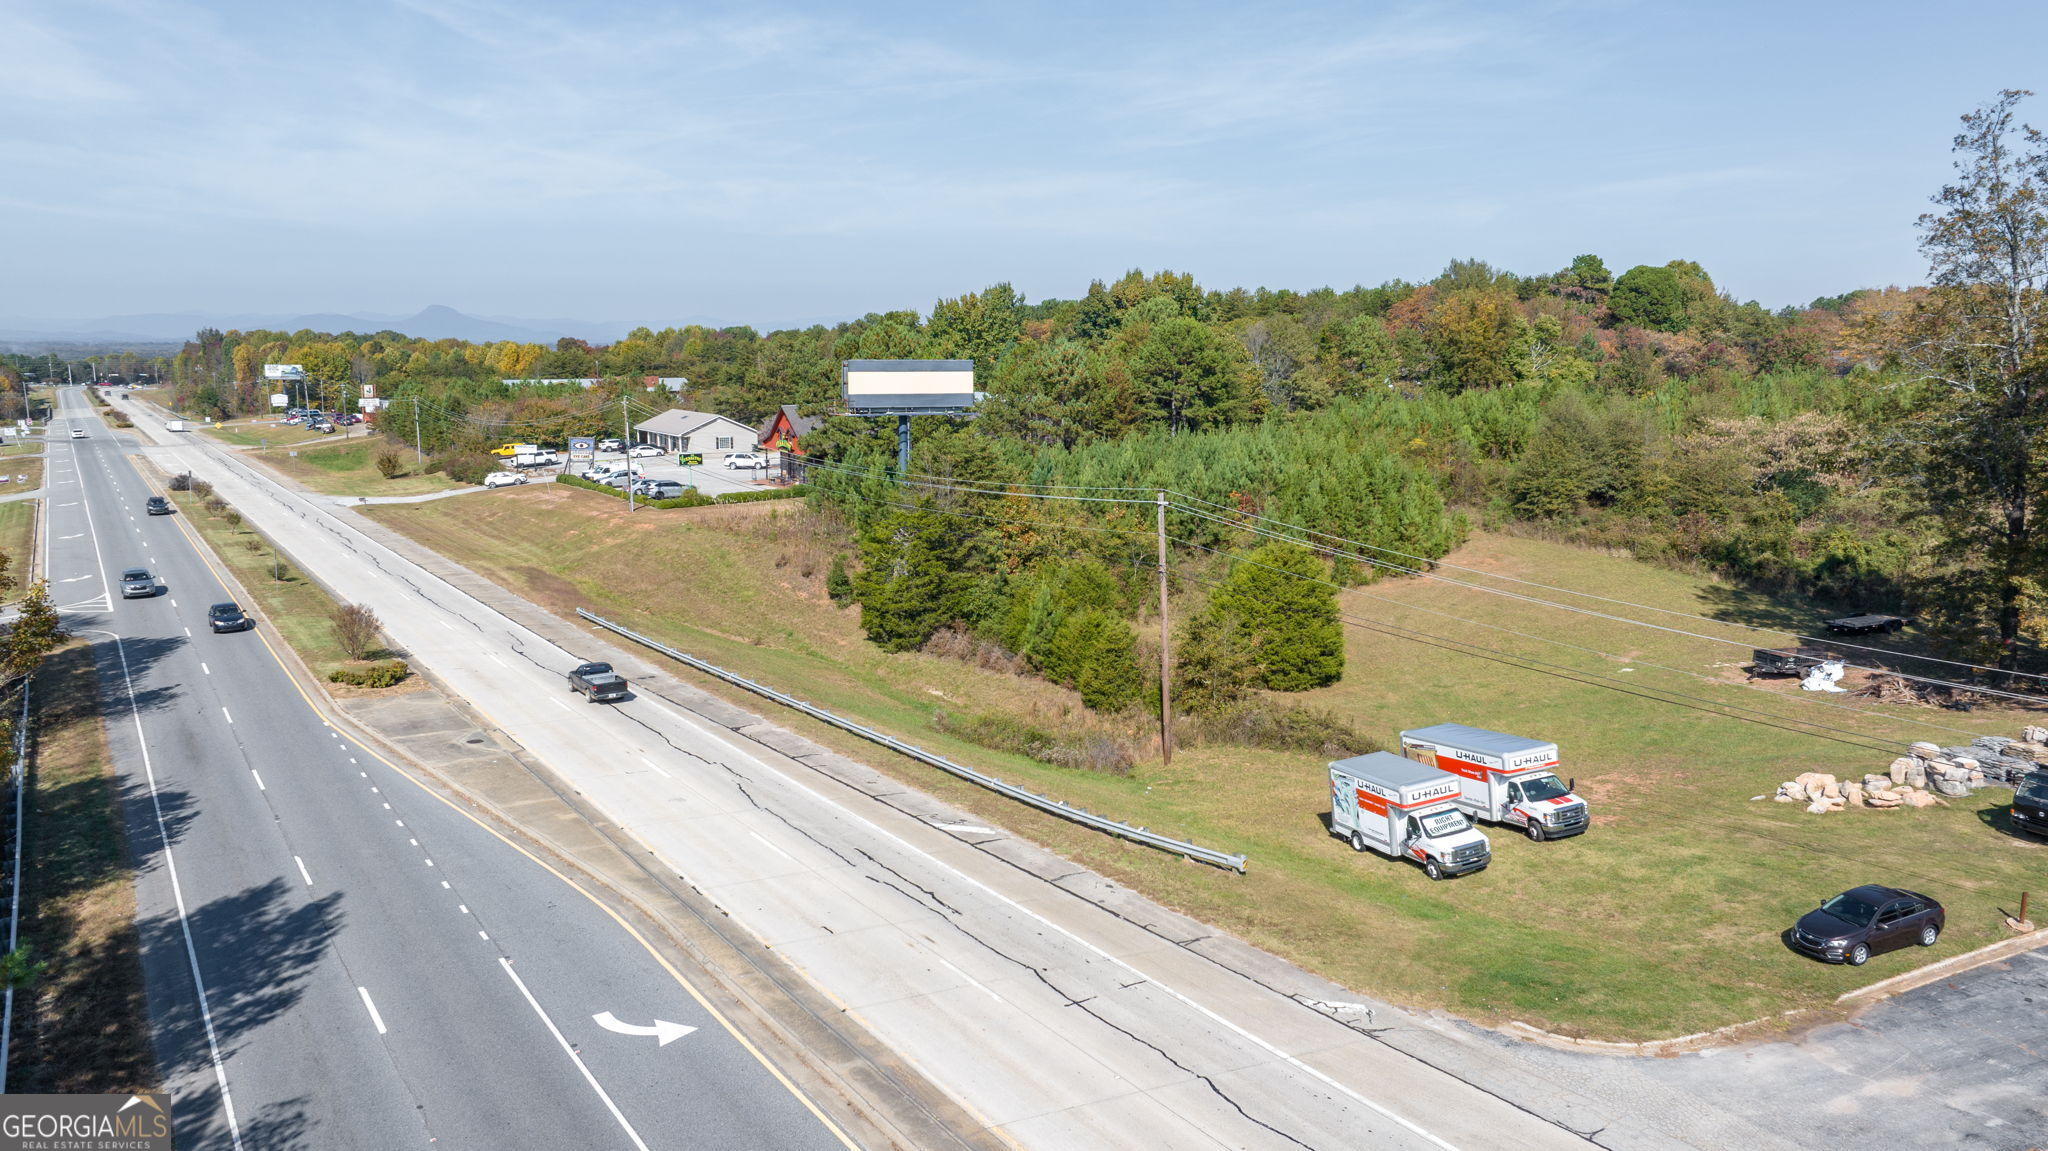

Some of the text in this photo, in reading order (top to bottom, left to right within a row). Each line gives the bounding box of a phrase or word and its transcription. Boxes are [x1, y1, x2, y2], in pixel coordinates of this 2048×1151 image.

[1455, 750, 1488, 765] U-HAUL
[1514, 753, 1553, 767] U-HAUL
[1357, 779, 1387, 797] U-HAUL
[1412, 784, 1454, 801] U-HAUL
[1430, 819, 1465, 834] EQUIPMENT
[1434, 814, 1455, 826] RIGHT
